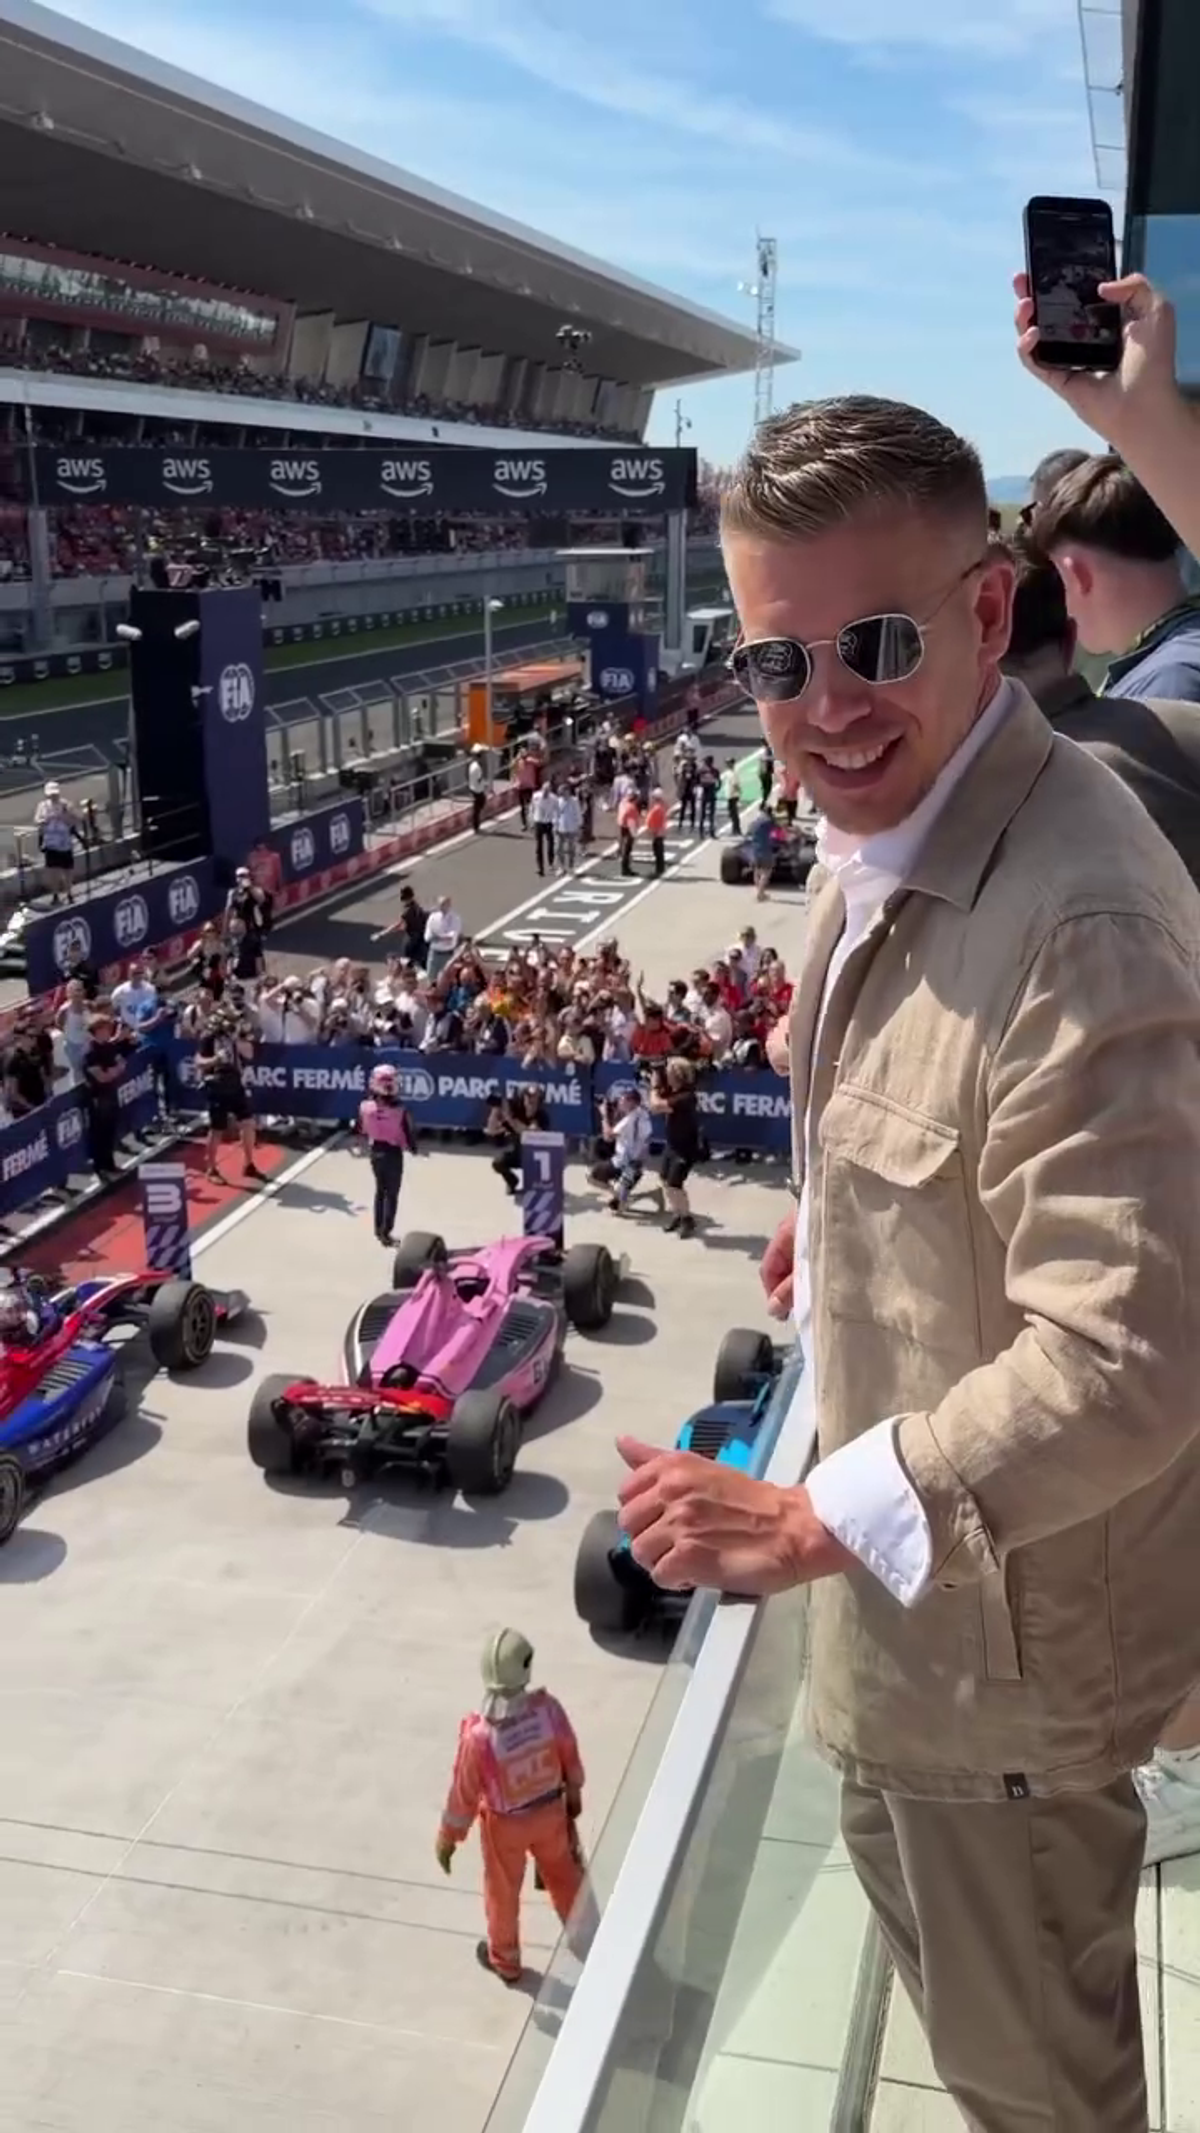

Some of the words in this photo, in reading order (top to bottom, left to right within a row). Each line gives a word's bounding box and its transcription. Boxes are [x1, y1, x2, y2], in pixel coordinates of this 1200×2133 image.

[57, 457, 105, 478] aws
[163, 458, 211, 479] aws
[270, 459, 320, 482] aws
[381, 459, 432, 482] aws
[494, 459, 546, 482] aws
[610, 457, 664, 481] aws
[601, 672, 632, 690] FIA
[169, 883, 199, 919] FIA
[115, 902, 147, 940] FIA
[117, 1063, 154, 1108] FERMÉ
[242, 1065, 287, 1087] ARC
[293, 1064, 366, 1091] FERMÉ
[438, 1076, 499, 1099] PARC
[695, 1091, 726, 1114] RC
[732, 1092, 791, 1118] FERM
[2, 1129, 49, 1182] FERMÉ
[58, 1113, 81, 1147] FIA
[533, 1151, 551, 1182] 1
[145, 1183, 182, 1214] 3
